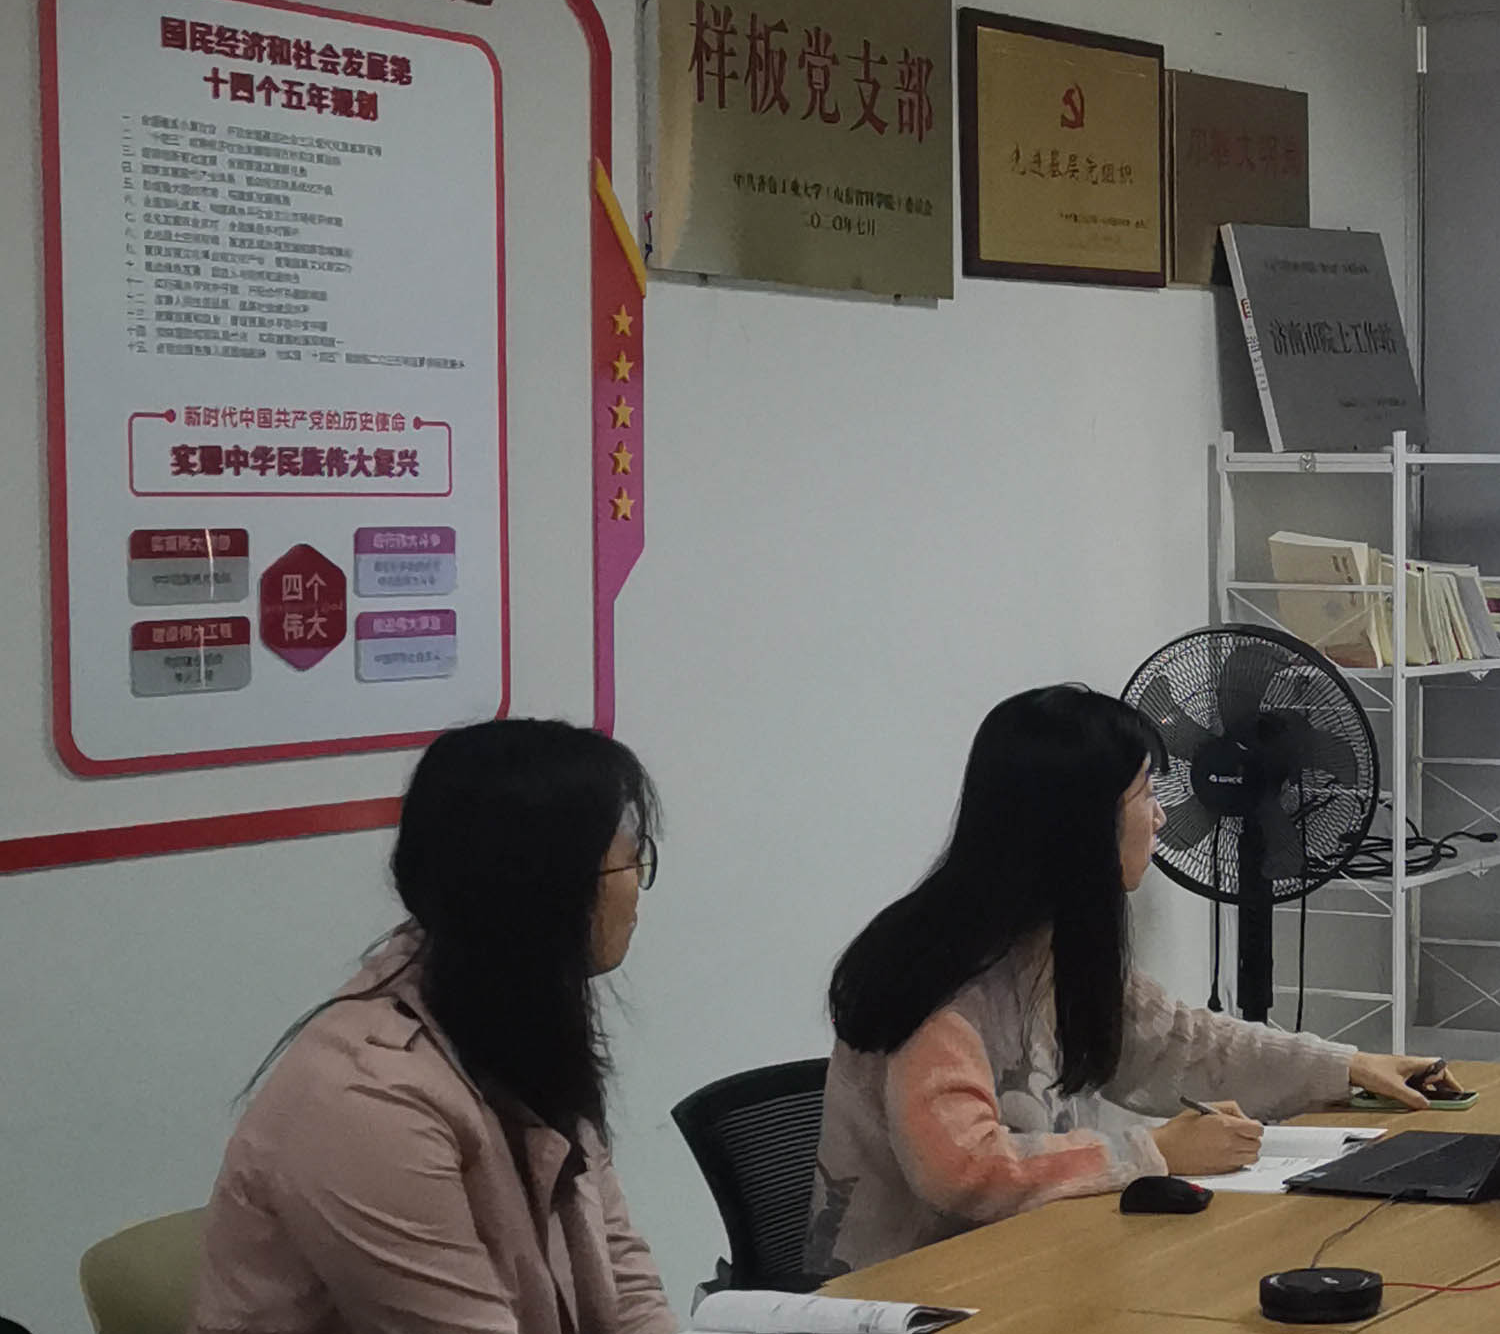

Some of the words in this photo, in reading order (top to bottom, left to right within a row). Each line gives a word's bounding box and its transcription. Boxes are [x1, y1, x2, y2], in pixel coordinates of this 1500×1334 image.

[161, 16, 412, 85] 国民经济和社会发展第
[688, 0, 934, 144] 样板党支部
[184, 406, 405, 432] 新时代中国共产党的历史使命
[170, 445, 420, 478] 实现中华民族伟大复兴
[281, 572, 327, 601] 四个
[282, 612, 329, 640] 伟大
